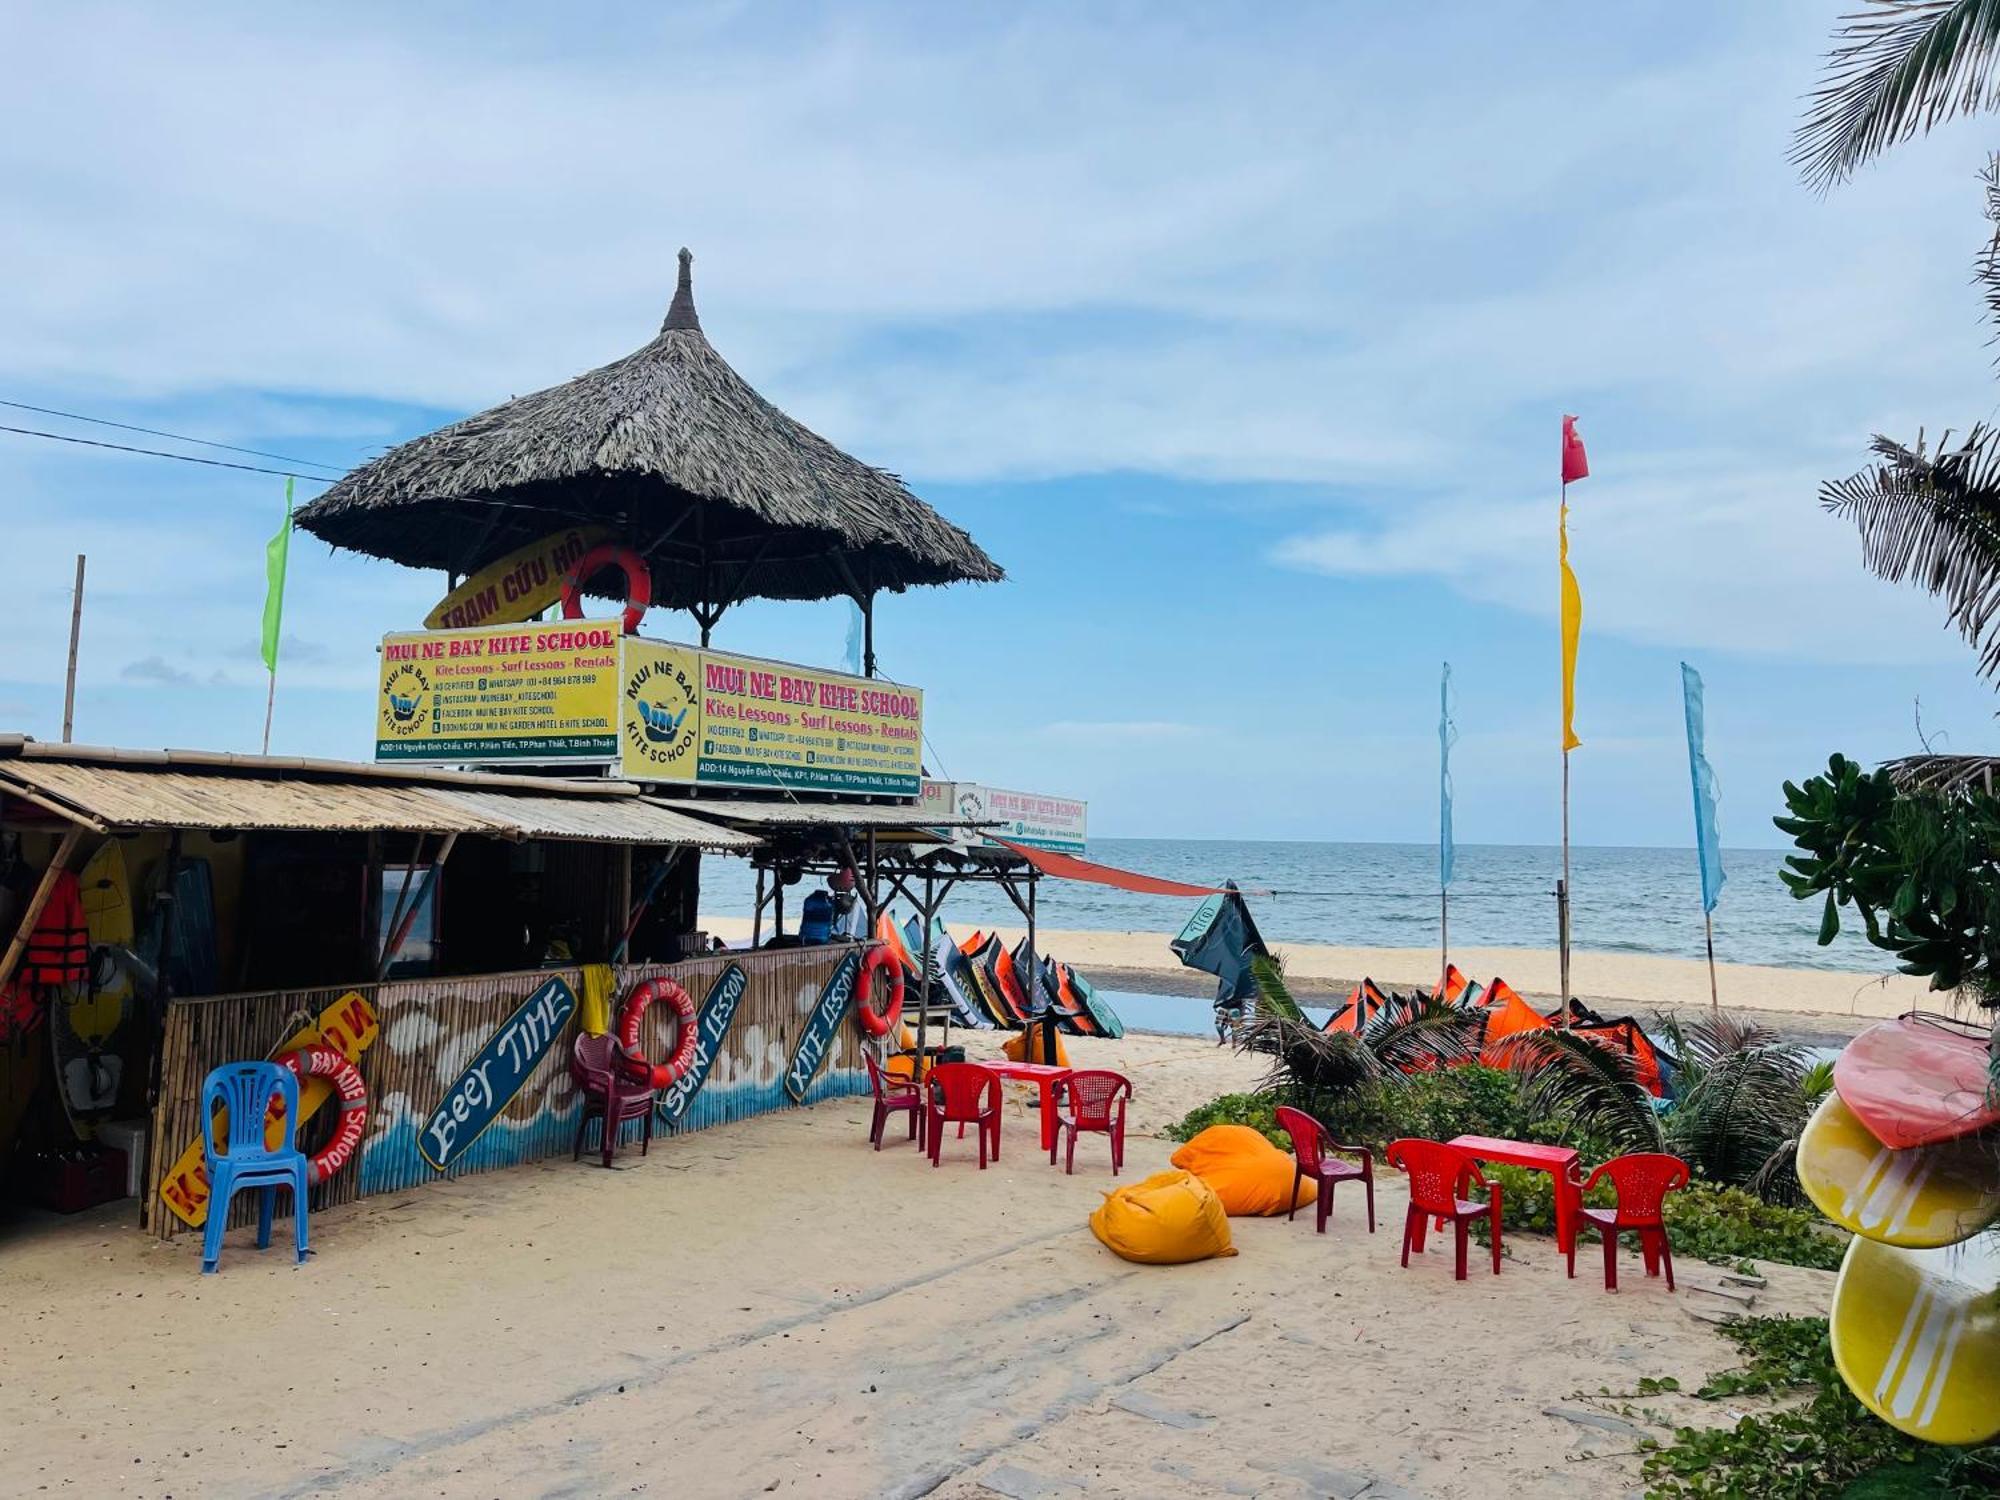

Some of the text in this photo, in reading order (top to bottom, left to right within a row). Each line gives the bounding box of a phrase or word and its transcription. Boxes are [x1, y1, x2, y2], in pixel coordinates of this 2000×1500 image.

[386, 630, 615, 661] MUI NE BAY KITE SCHOOL
[384, 664, 430, 695] MUI NE BAY
[435, 664, 454, 677] Kite
[455, 662, 493, 675] Lessons
[501, 660, 524, 672] Surf
[525, 660, 566, 671] Lessons
[574, 655, 615, 668] Rentals
[626, 661, 697, 705] MUI NE BAY
[706, 664, 919, 720] MUI NE BAY KITE SCHOOL
[383, 708, 429, 736] KITE SCHOOL
[536, 719, 557, 729] HOTEL
[582, 718, 608, 728] SCHOOL
[706, 698, 736, 718] Kite
[738, 703, 791, 725] Lessons
[801, 711, 826, 730] Surf
[829, 715, 873, 736] Lessons
[881, 722, 918, 741] Rentals
[626, 721, 697, 763] KITE SCHOOL
[658, 981, 678, 997] BAY
[674, 993, 694, 1017] KITE
[704, 967, 746, 1042] LESSON
[497, 983, 571, 1074] TIME
[674, 1024, 698, 1072] SCHOOL
[310, 1051, 341, 1075] BAY
[790, 1023, 826, 1093] KITE
[334, 1064, 365, 1100] KITE
[317, 1111, 367, 1174] SCHOOL
